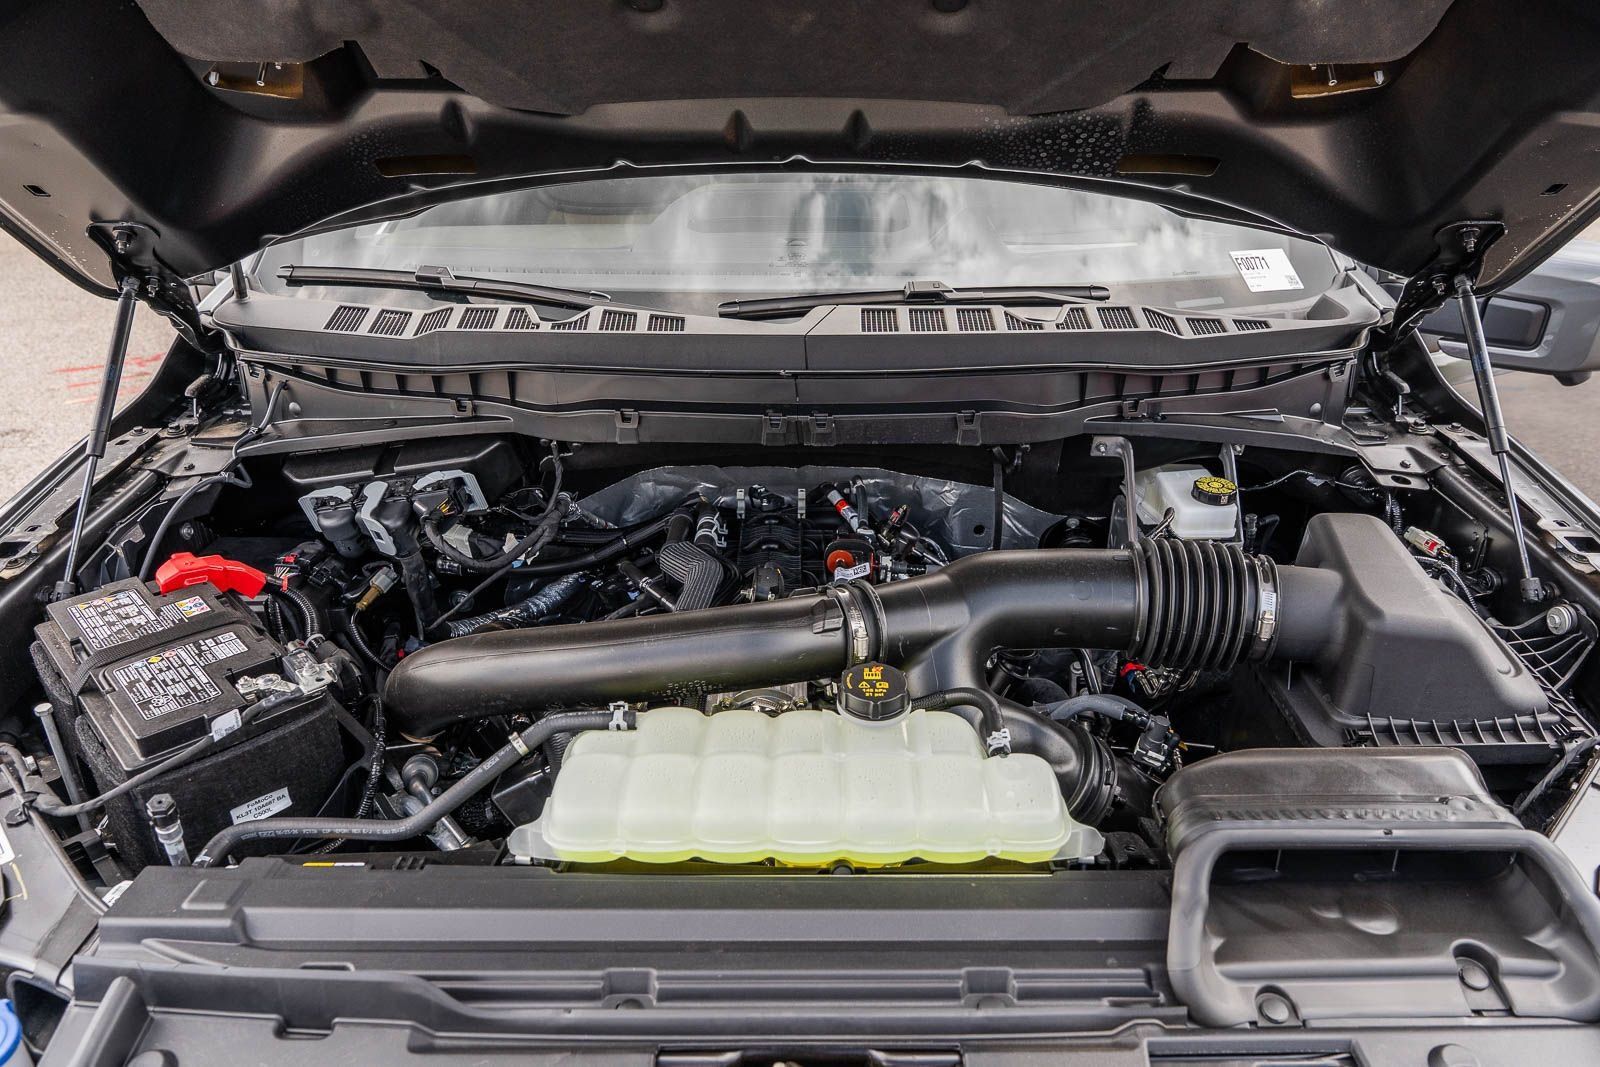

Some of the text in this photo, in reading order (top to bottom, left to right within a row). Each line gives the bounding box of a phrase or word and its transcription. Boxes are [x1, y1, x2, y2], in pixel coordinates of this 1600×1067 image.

[1235, 256, 1270, 271] F00771
[247, 794, 273, 808] FoMoCo
[236, 810, 253, 820] KL3T
